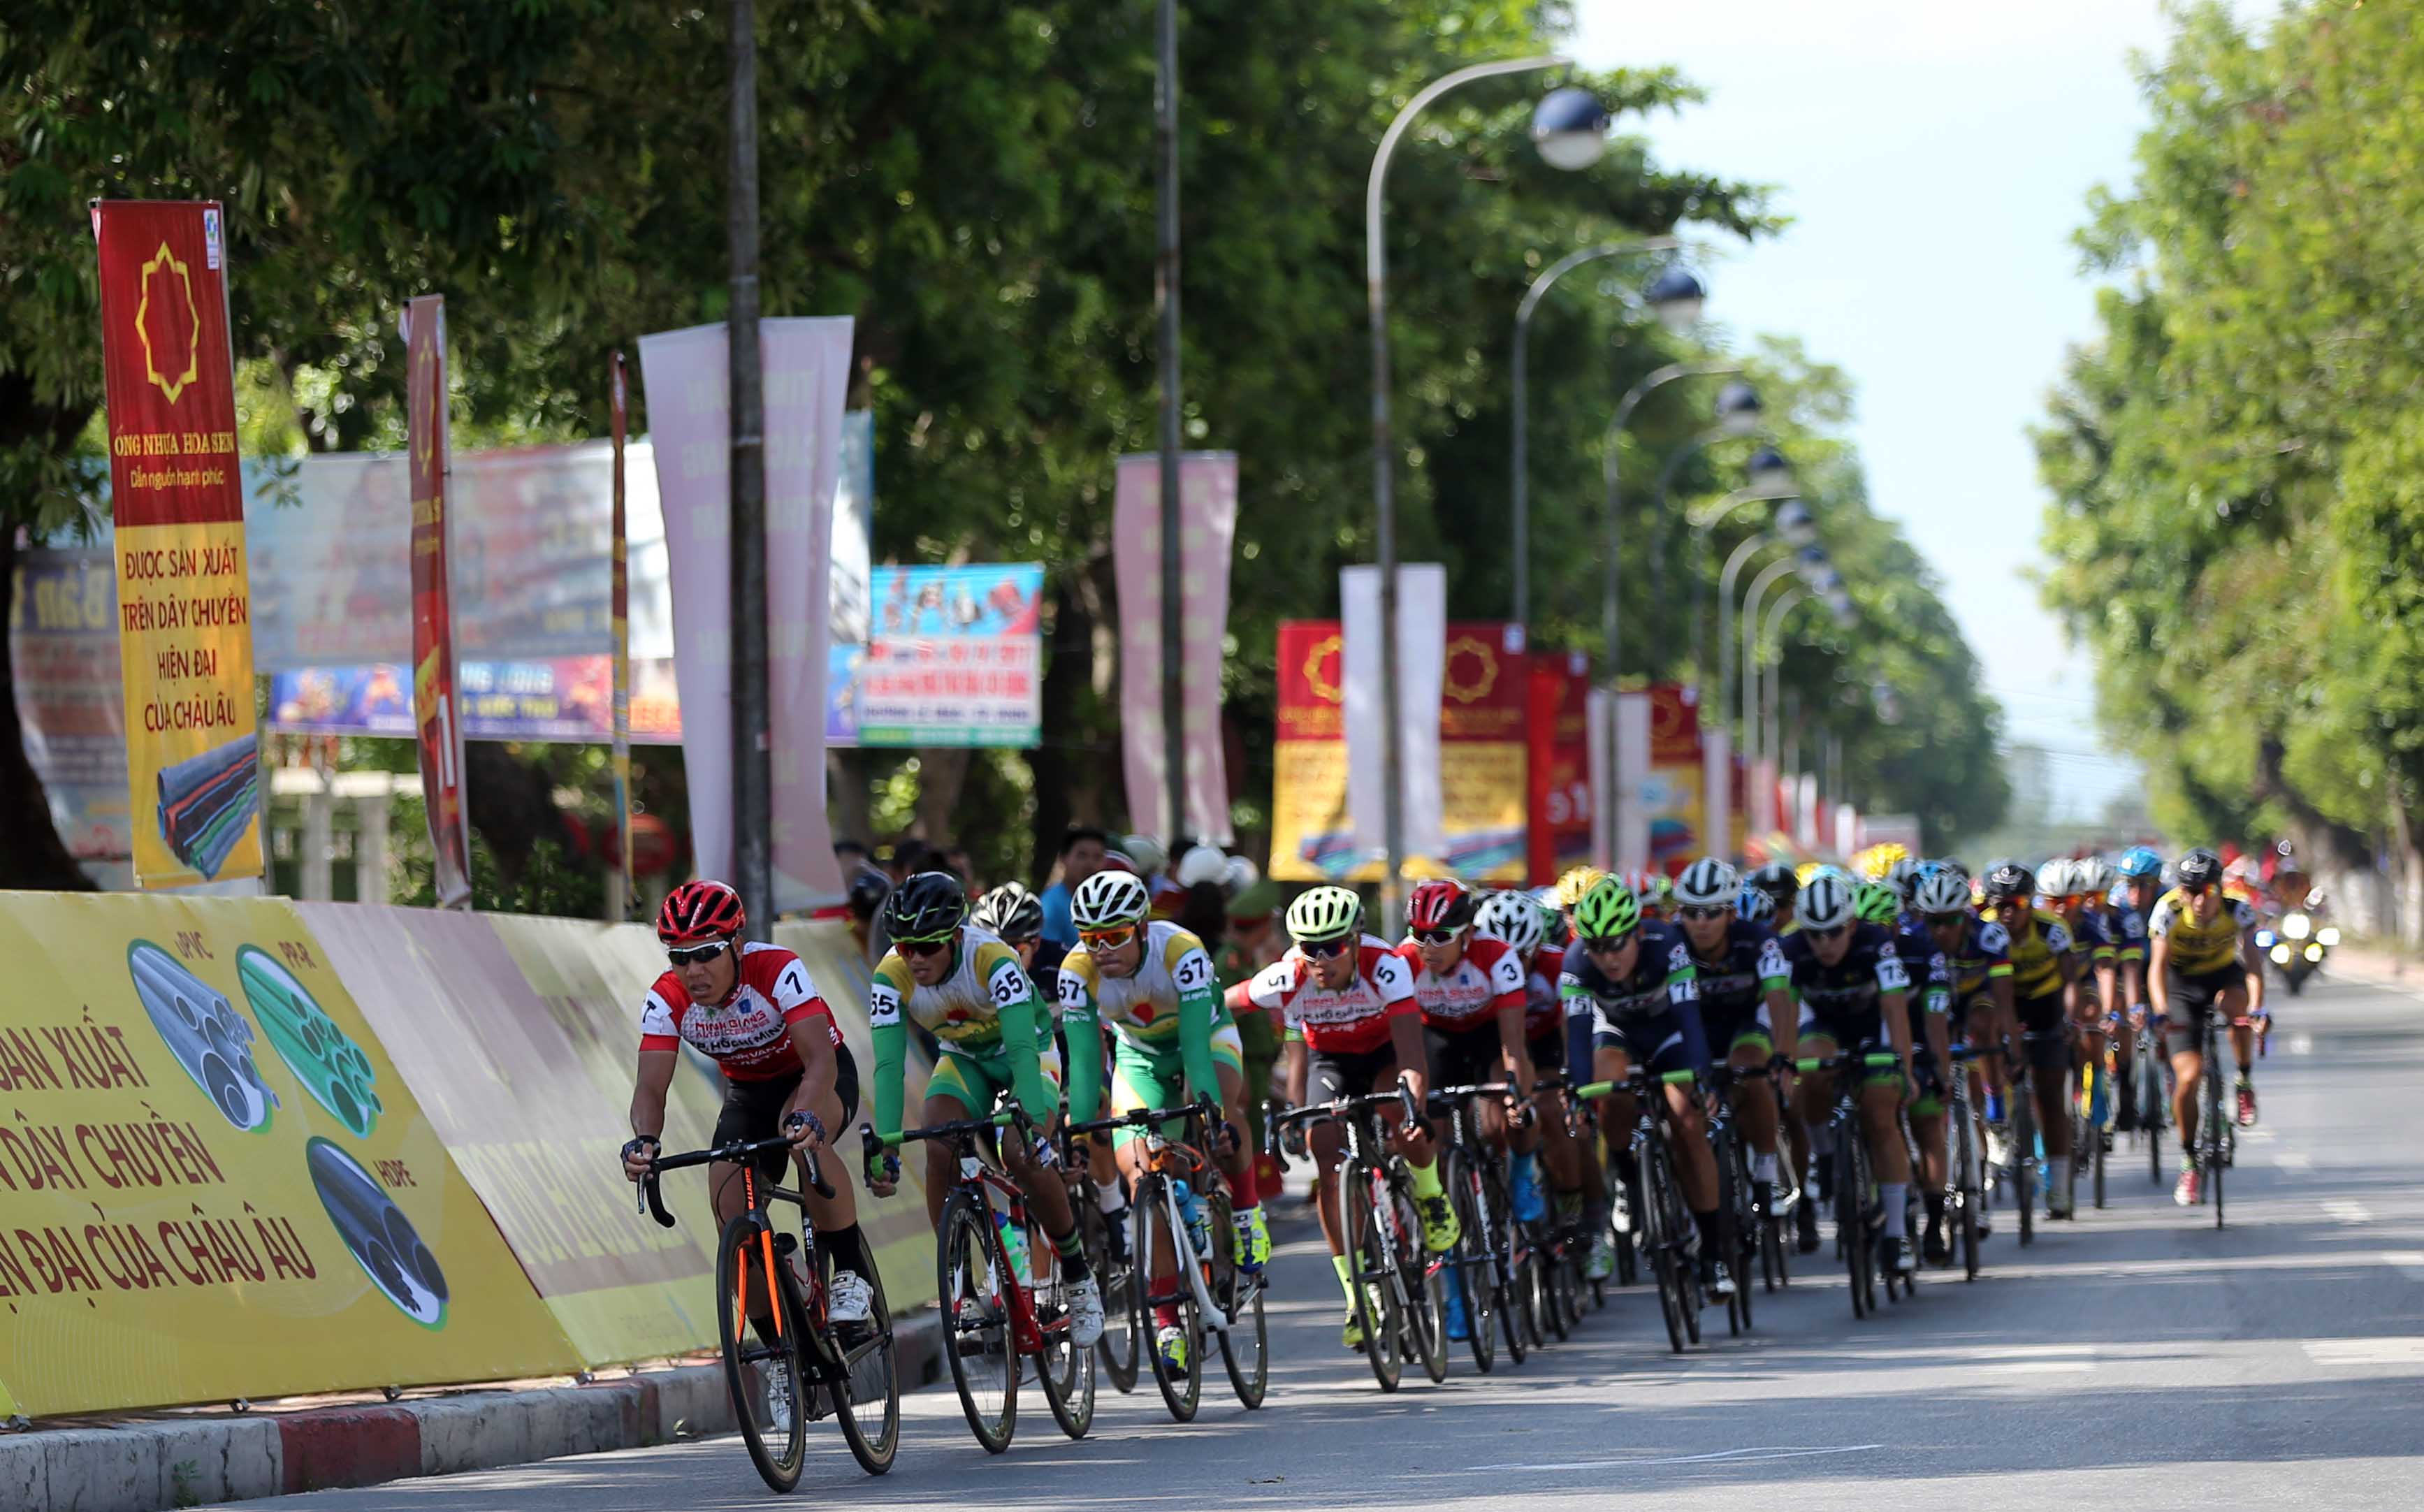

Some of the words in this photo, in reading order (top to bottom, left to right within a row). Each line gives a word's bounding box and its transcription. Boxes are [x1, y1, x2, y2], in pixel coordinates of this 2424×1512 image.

[183, 432, 210, 454] HOA
[211, 431, 235, 453] SEN
[169, 539, 196, 578] SẢN
[203, 537, 238, 576] XUẤT
[122, 595, 154, 632] TRÊN
[159, 593, 187, 629] DÂY
[191, 588, 247, 627] CHUYỀN
[157, 644, 189, 685] HIỆN
[194, 648, 217, 683] ĐẠI
[145, 694, 172, 733] CỦA
[174, 693, 214, 730] CHÂU
[216, 691, 235, 726] ÂU
[785, 971, 803, 995] 7
[1179, 957, 1205, 984] 57
[1268, 975, 1286, 987] 5
[1377, 966, 1395, 984] 5
[1503, 964, 1518, 981] 3
[995, 971, 1023, 1002] 55
[1059, 979, 1080, 1001] 57
[695, 1022, 726, 1032] MINH
[39, 1003, 150, 1090] XUẤT
[0, 1107, 88, 1191] DÂY
[75, 1100, 226, 1189] CHUYỀN
[372, 1160, 418, 1187] HDPE
[13, 1225, 103, 1309] ĐẠI
[84, 1201, 179, 1291] CỦA
[158, 1202, 266, 1287] CHÂU
[243, 1200, 317, 1281] ÂU
